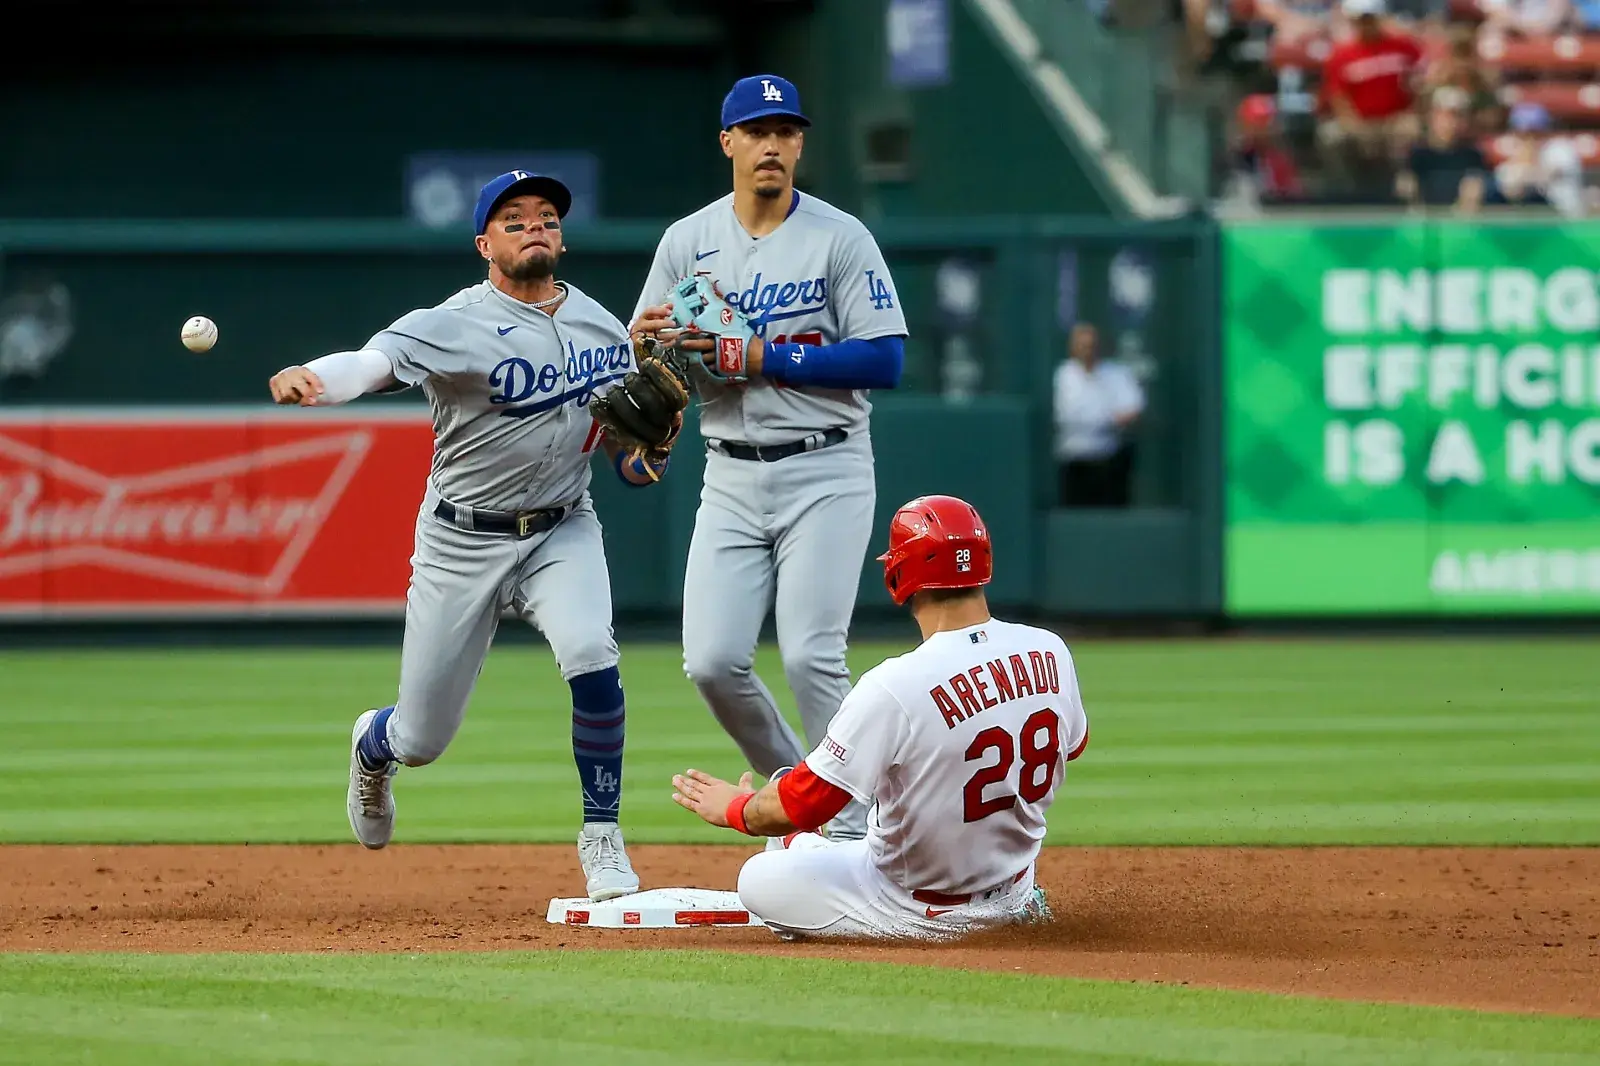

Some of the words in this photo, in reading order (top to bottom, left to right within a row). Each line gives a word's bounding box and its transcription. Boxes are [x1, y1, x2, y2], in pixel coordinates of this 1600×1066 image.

[761, 80, 783, 102] LA
[725, 272, 827, 339] odgers
[865, 270, 894, 310] LA
[1322, 266, 1600, 334] ENERG
[489, 339, 631, 408] Dodgers
[1323, 343, 1600, 410] EFFICI
[1323, 419, 1405, 485] IS
[1427, 420, 1484, 484] A
[956, 549, 971, 563] 28
[930, 650, 1060, 730] ARENADO
[594, 765, 618, 792] LA
[963, 707, 1060, 823] 28
